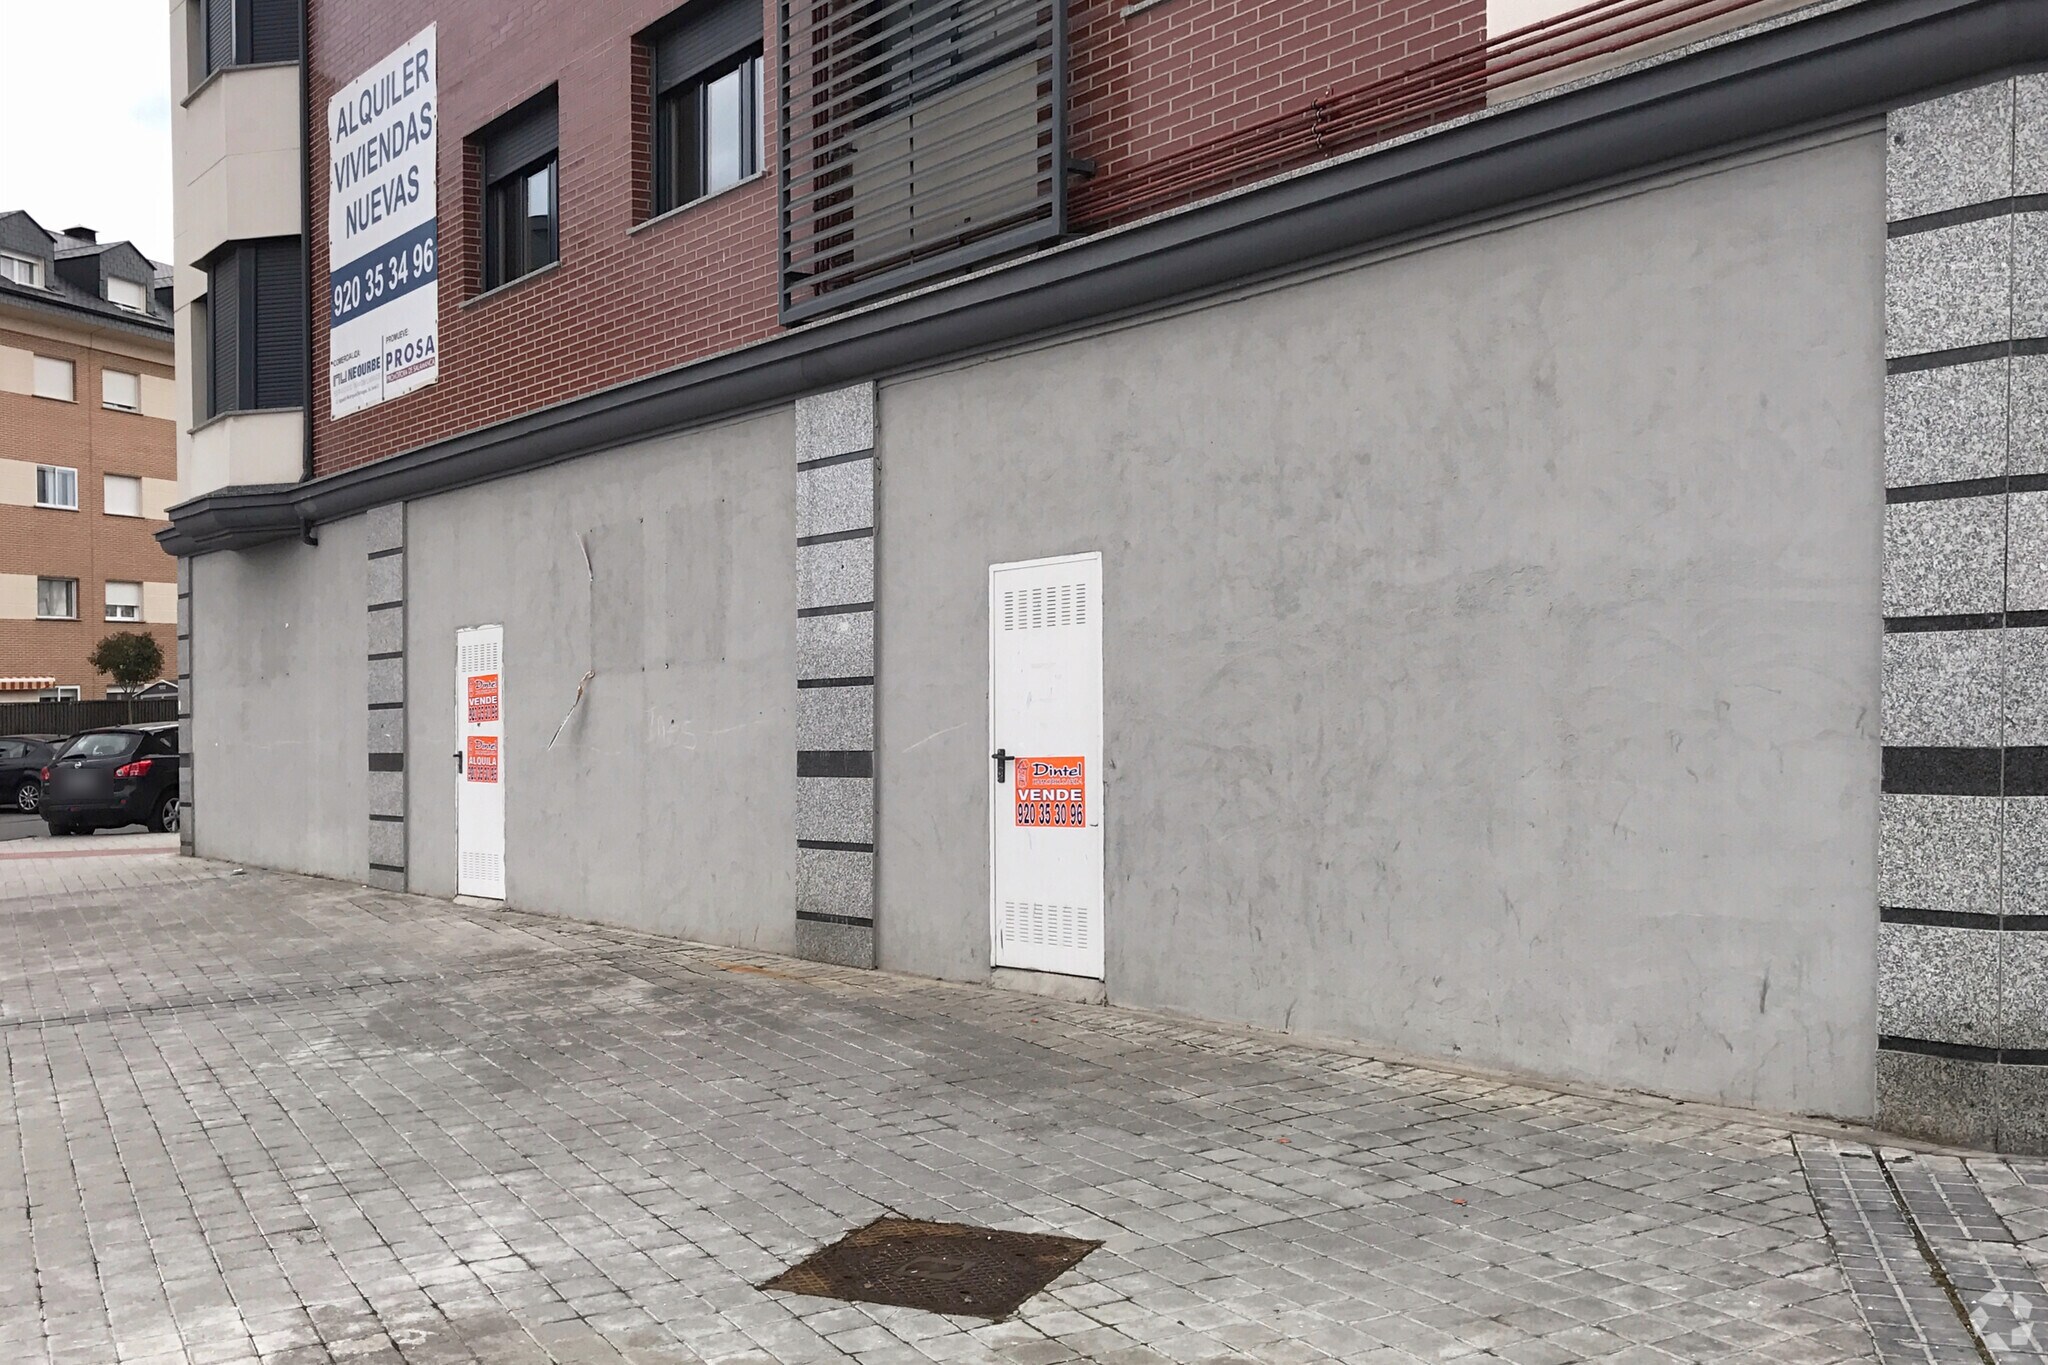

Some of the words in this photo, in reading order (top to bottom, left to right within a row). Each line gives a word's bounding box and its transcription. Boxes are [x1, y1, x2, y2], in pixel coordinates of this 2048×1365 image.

[336, 48, 429, 143] ALQUILER
[334, 102, 432, 193] VIVIENDAS
[346, 165, 419, 239] NUEVAS
[334, 276, 361, 316] 920
[365, 262, 384, 301] 35
[388, 249, 408, 291] 34
[413, 237, 433, 279] 96
[386, 335, 435, 371] PROSA
[348, 356, 381, 380] NEOURBE
[469, 696, 498, 706] VENDE
[468, 756, 497, 766] ALQUILA
[1033, 762, 1082, 777] Dintel
[1018, 789, 1082, 801] VENDE
[1018, 803, 1036, 824] 920
[1039, 803, 1051, 824] 35
[1054, 803, 1066, 824] 30
[1070, 803, 1083, 825] 96
